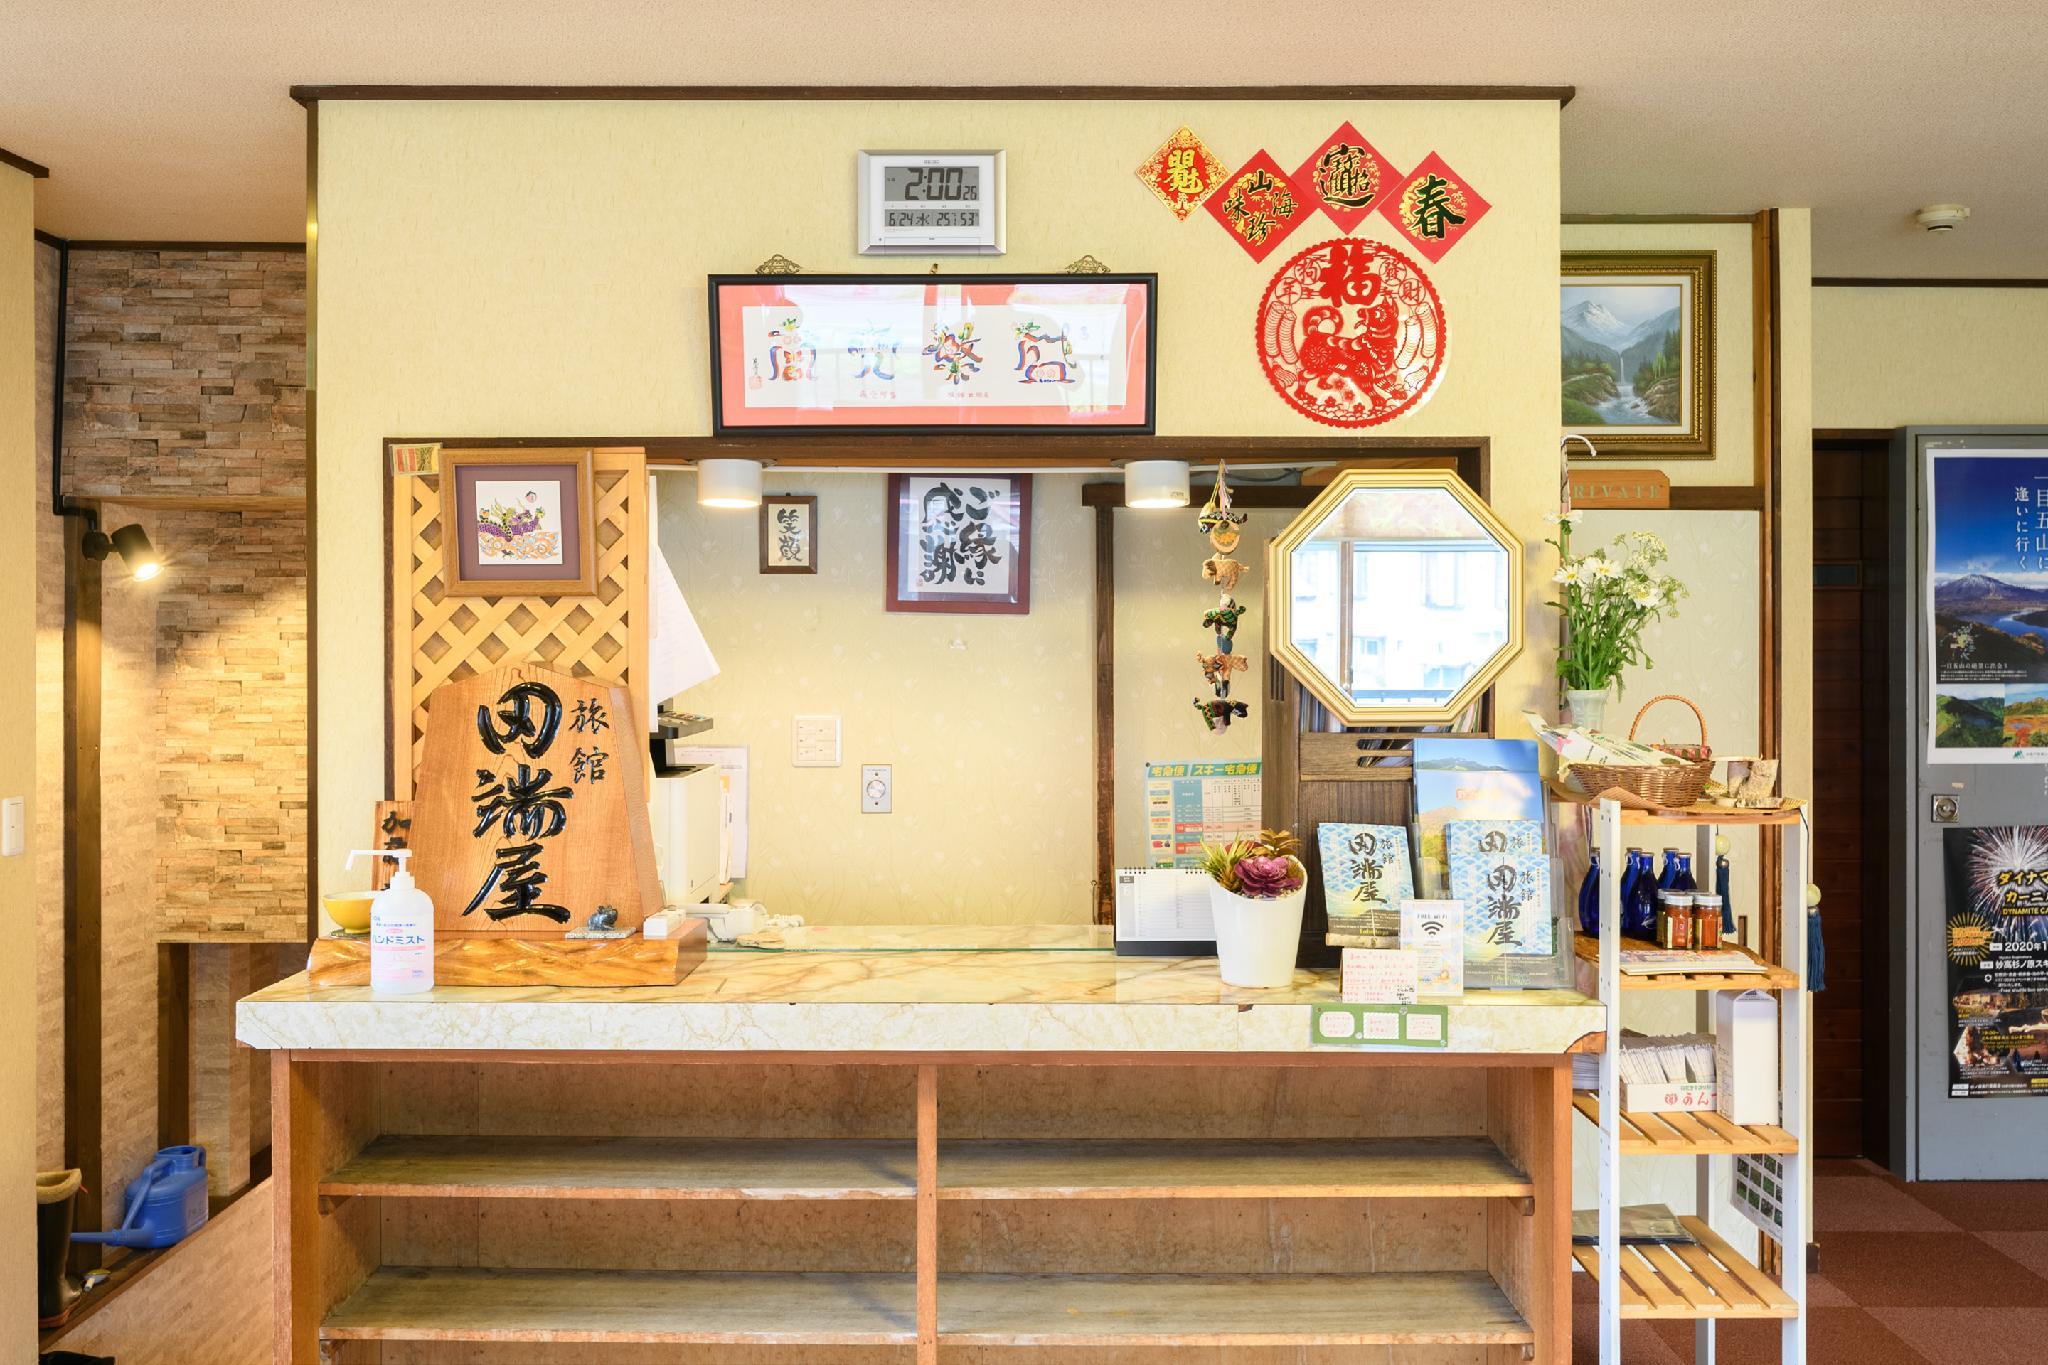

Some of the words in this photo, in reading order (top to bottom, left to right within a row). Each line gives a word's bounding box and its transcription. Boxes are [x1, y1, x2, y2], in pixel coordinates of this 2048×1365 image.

[905, 168, 963, 200] 2:00
[963, 186, 977, 200] 26
[1415, 174, 1467, 238] 春
[899, 213, 914, 226] 24
[1320, 245, 1382, 305] 福
[1573, 482, 1659, 499] RIVATE
[2014, 486, 2030, 569] 逢いに行く
[569, 697, 609, 785] 旅館
[461, 682, 574, 925] 田端屋
[2003, 907, 2038, 915] DYNAMITE
